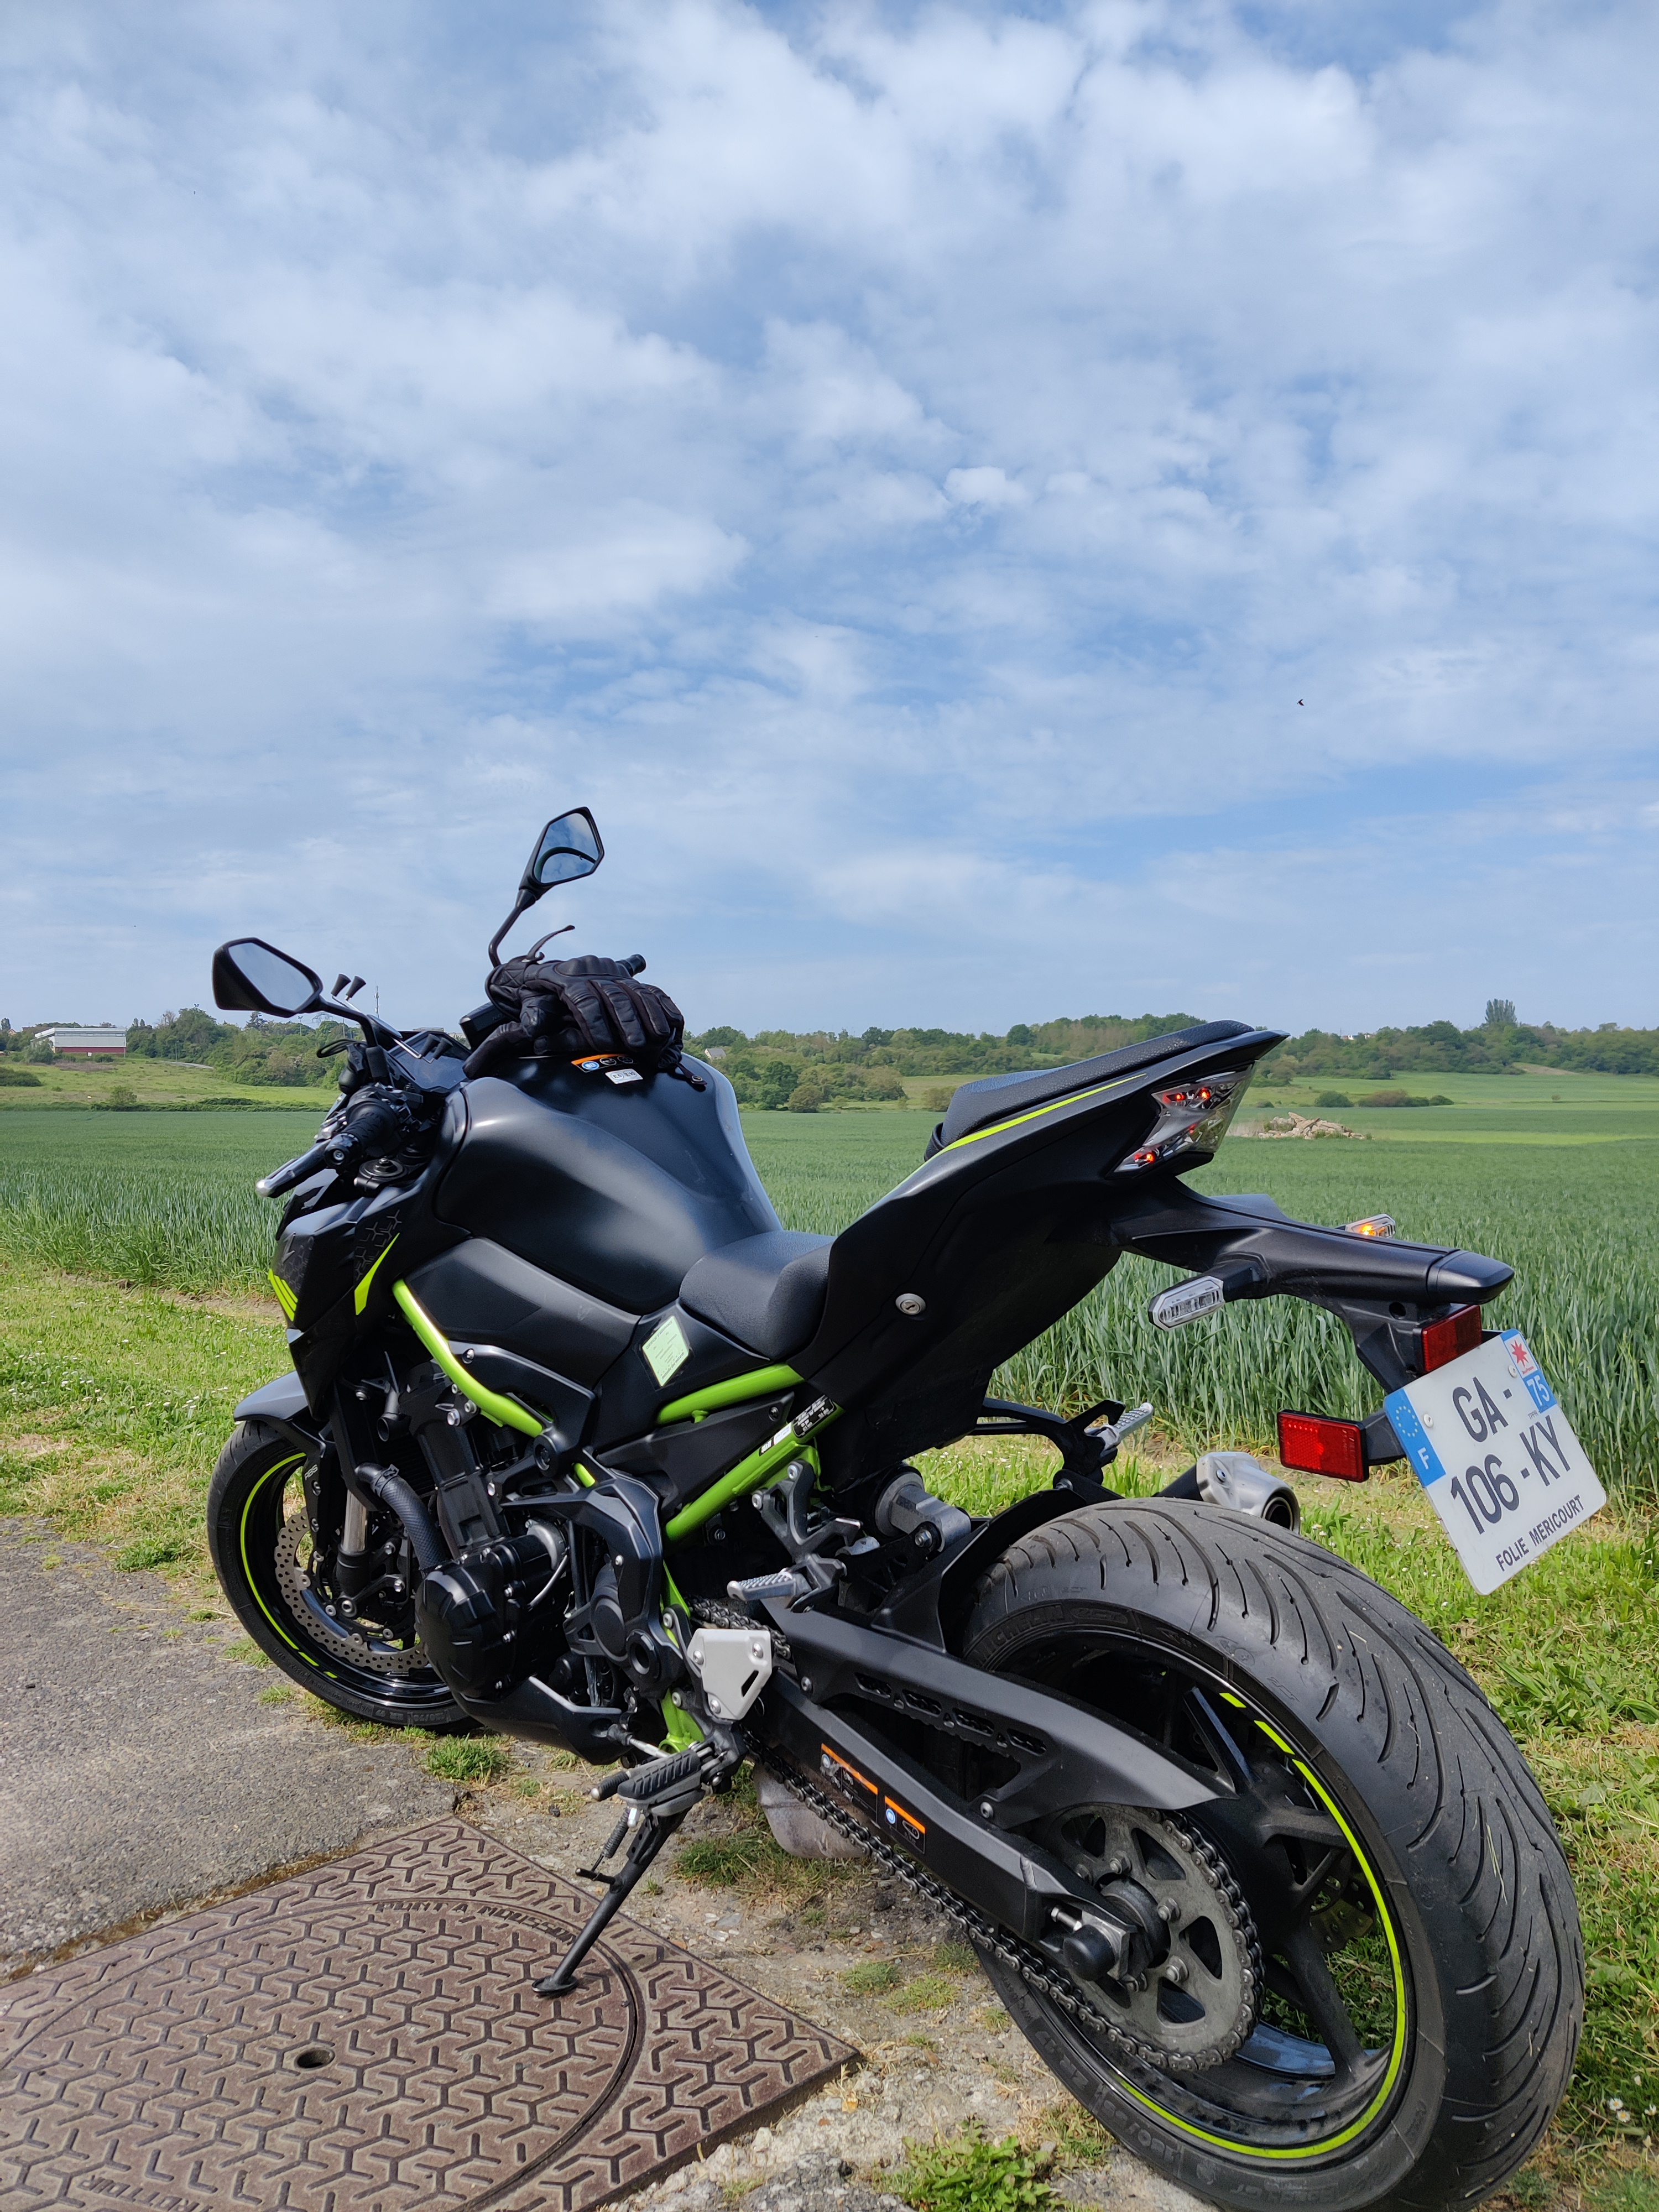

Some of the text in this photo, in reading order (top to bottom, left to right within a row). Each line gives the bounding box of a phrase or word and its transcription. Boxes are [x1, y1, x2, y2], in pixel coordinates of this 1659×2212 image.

[1526, 1374, 1550, 1406] 75
[304, 1464, 318, 1480] ABS
[1417, 1447, 1430, 1470] F
[1496, 1494, 1585, 1572] FOLIE MERICOURT
[450, 1903, 469, 1914] A
[1059, 2054, 1089, 2090] ZR
